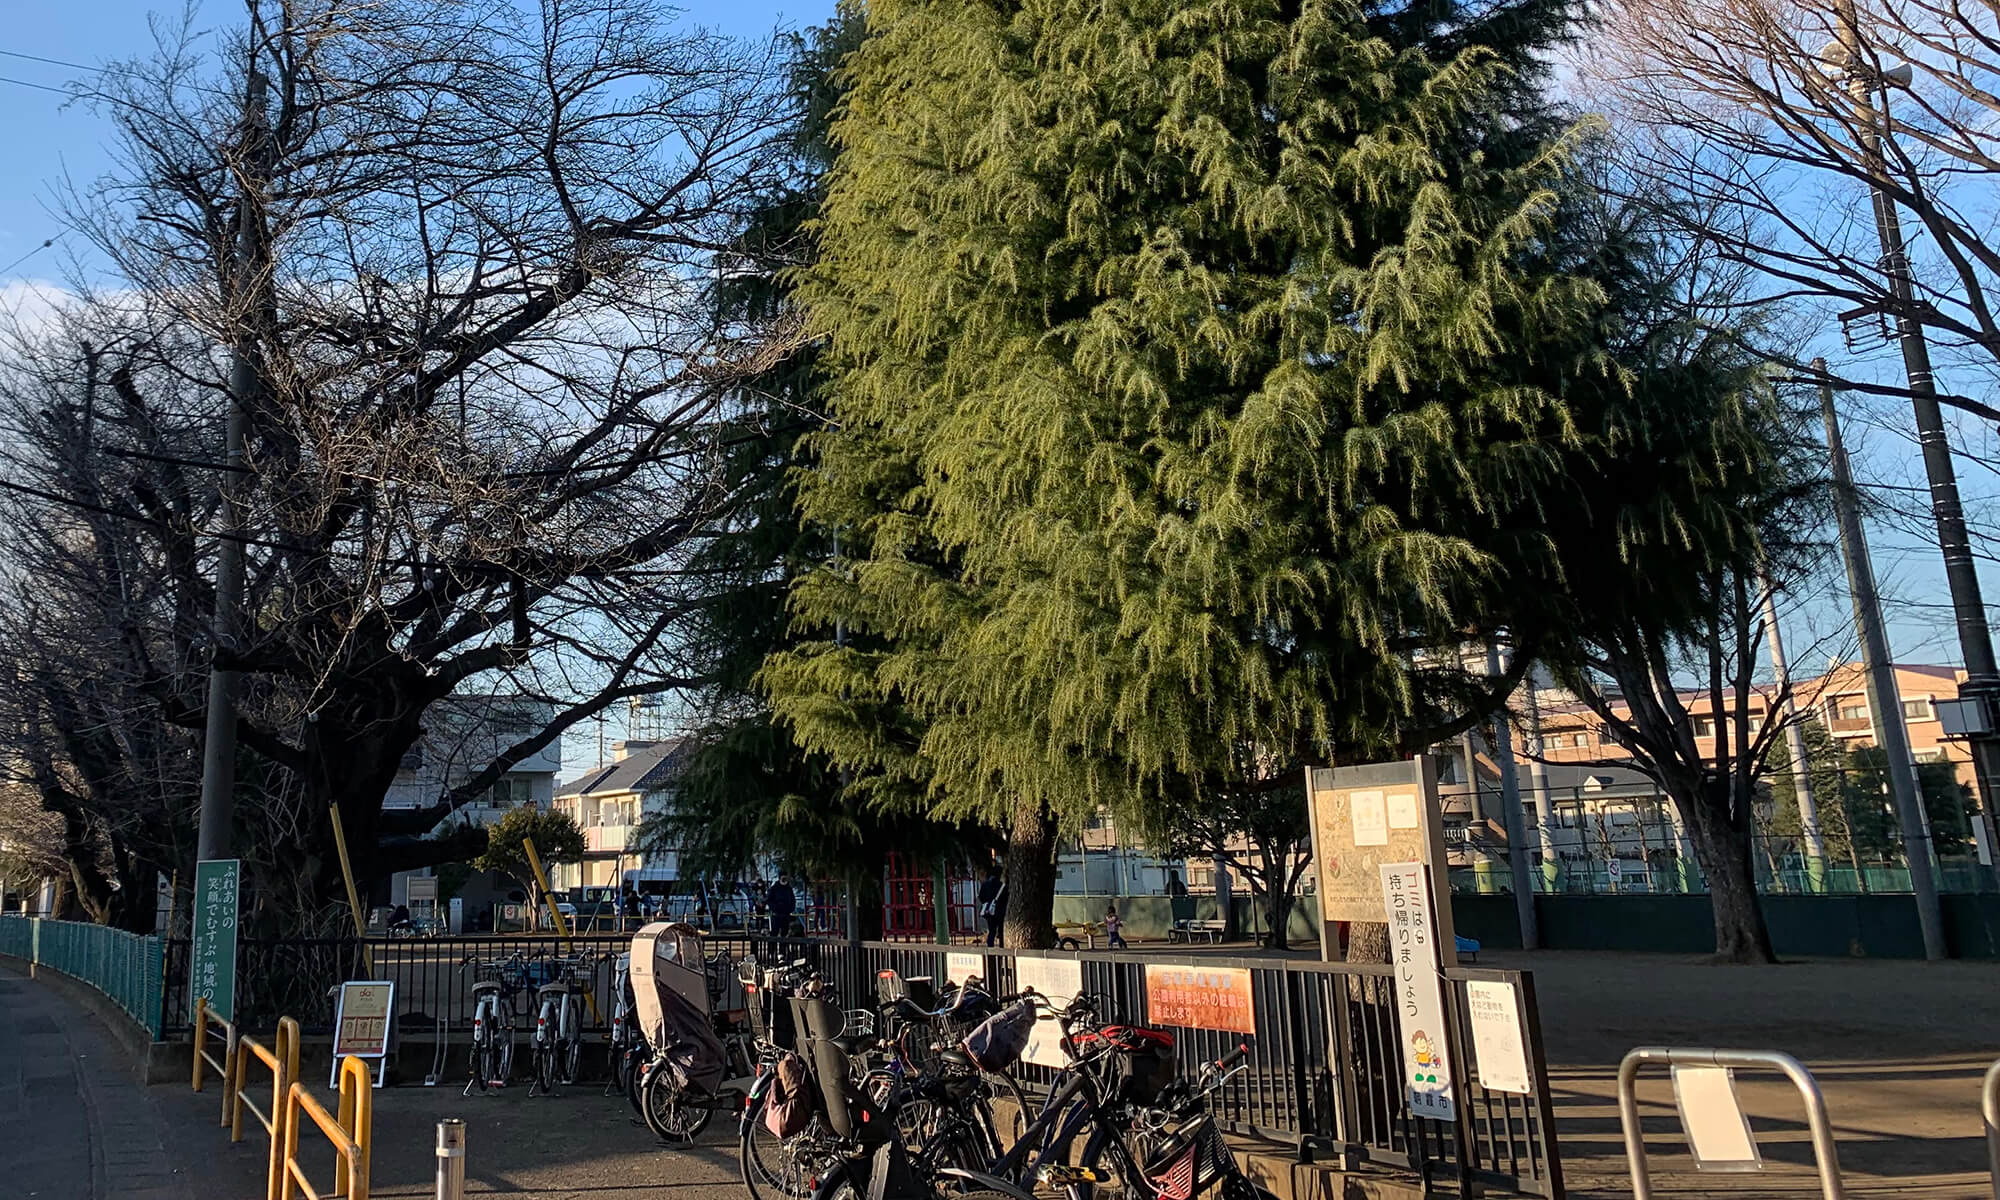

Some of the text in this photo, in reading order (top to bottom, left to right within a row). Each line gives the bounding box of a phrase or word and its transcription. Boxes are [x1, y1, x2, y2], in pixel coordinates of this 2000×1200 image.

[204, 877, 219, 957] 笑顔でむすぶ
[222, 865, 236, 929] ふれあいの
[1405, 871, 1425, 927] ゴミは
[1389, 873, 1418, 1018] 持ち帰りましょう
